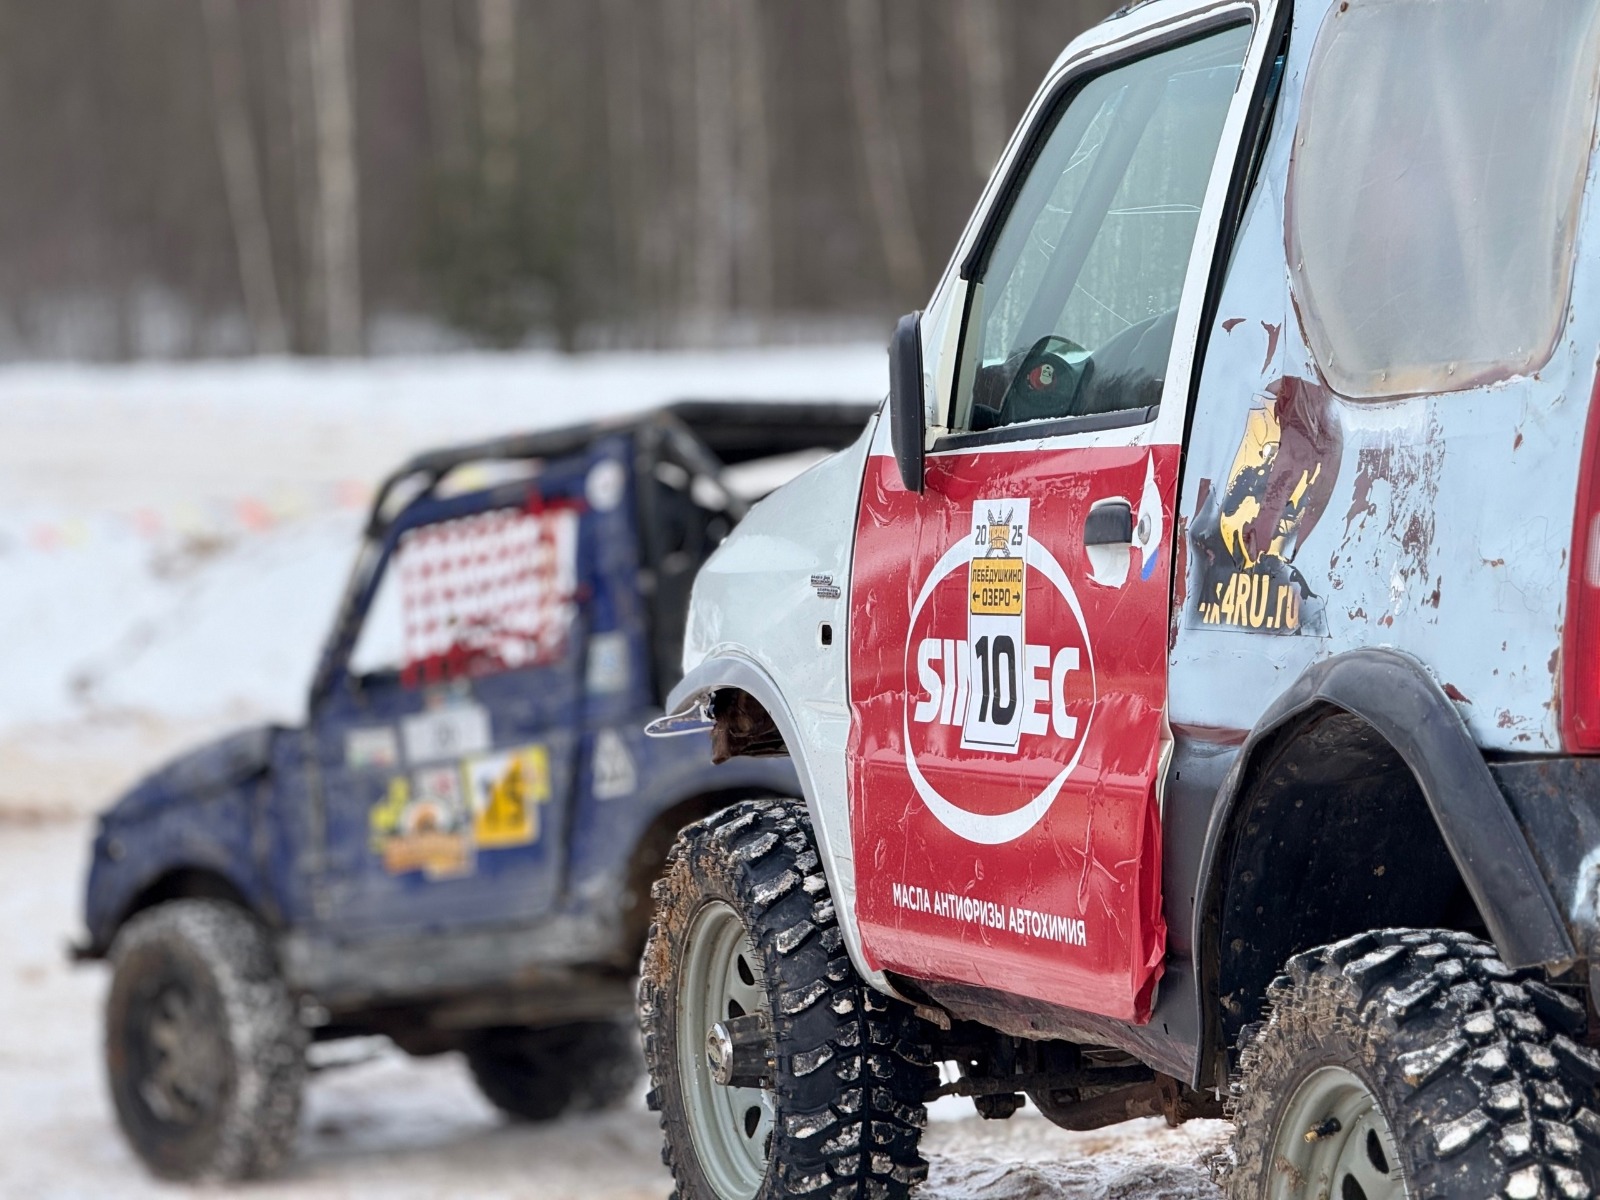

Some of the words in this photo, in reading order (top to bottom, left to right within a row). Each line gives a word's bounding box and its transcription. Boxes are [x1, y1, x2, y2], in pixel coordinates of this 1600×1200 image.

[975, 525, 986, 545] 20
[1011, 525, 1023, 545] 25
[972, 566, 1022, 584] ЛЕБЁДУШКИНО
[982, 588, 1011, 606] ОЗЕРО
[975, 635, 1017, 725] 10
[892, 882, 931, 913] МАСЛА
[934, 890, 1005, 930] АНТИФРИЗЫ
[1009, 907, 1087, 946] АВТОХИМИЯ
